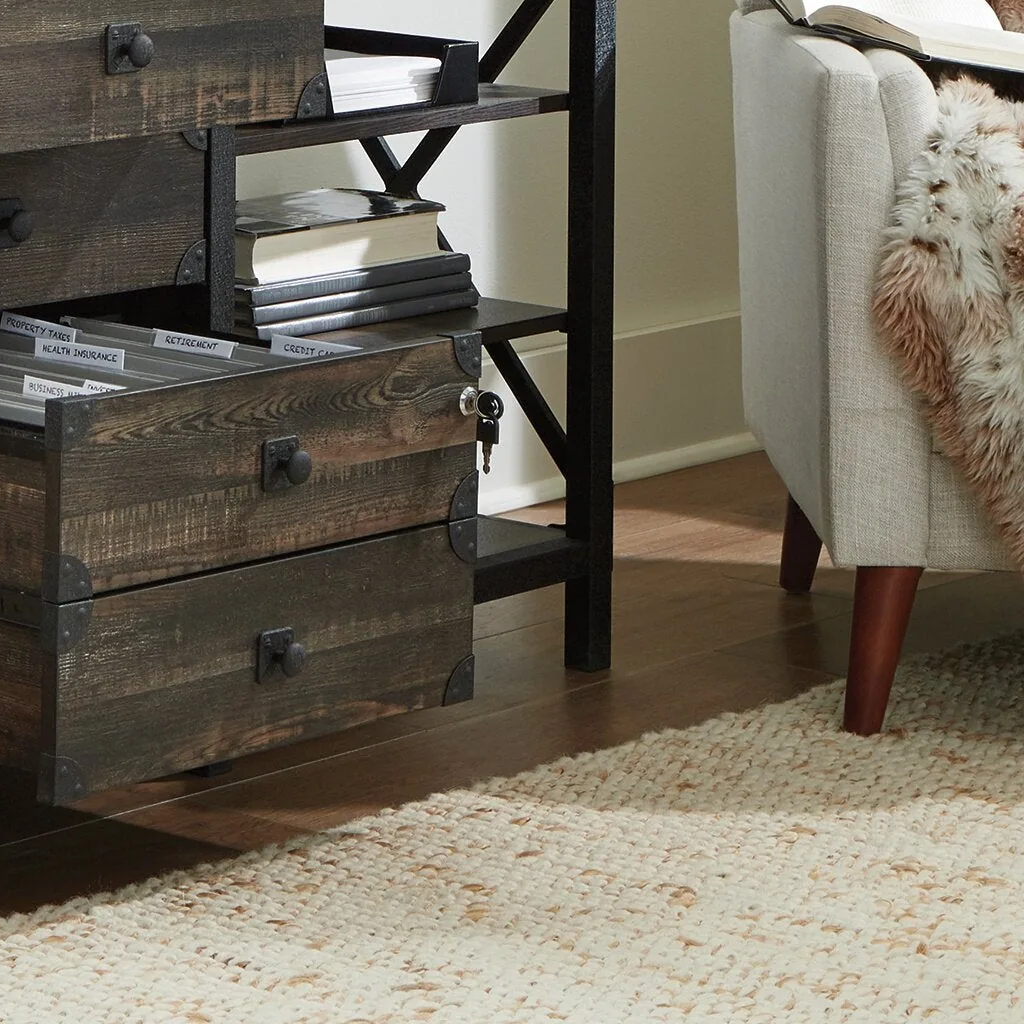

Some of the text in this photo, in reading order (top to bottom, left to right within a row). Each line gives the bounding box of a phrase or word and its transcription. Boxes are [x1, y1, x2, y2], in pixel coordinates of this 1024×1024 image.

[6, 317, 70, 343] PROPERTY TAXES
[164, 335, 219, 351] RETIREMENT
[283, 343, 316, 356] CREDIT
[42, 344, 118, 363] HEALTH INSURANCE
[29, 382, 65, 398] BUSINESS
